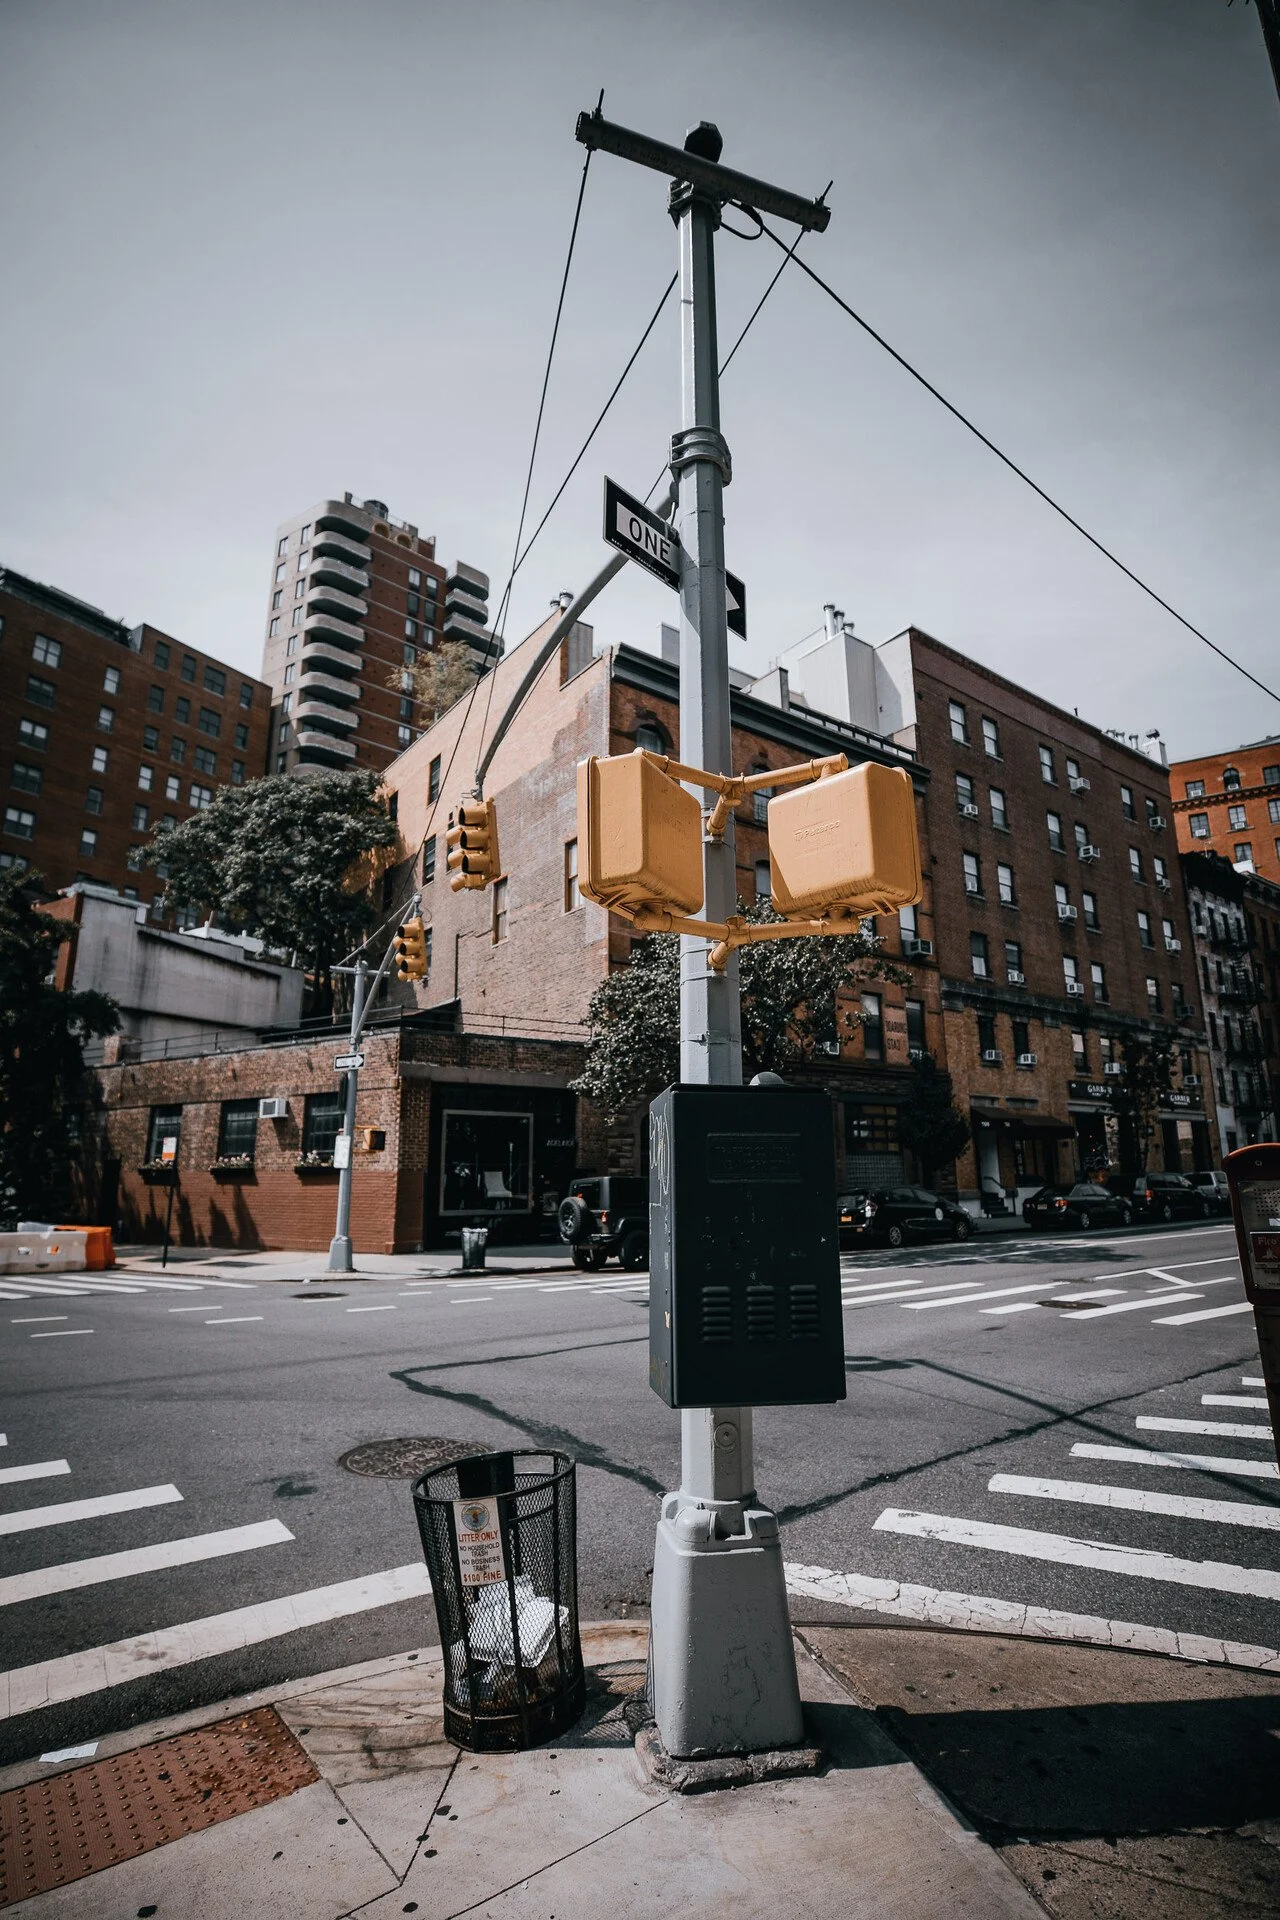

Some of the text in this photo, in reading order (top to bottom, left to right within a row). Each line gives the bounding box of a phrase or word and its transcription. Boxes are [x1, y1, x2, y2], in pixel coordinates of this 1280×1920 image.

[629, 517, 671, 566] ONE
[458, 1530, 498, 1543] LITTER ONLY
[467, 1541, 500, 1551] HOUSEHOLD
[471, 1555, 501, 1565] BUSINESS
[463, 1570, 502, 1583] $100 FINE
